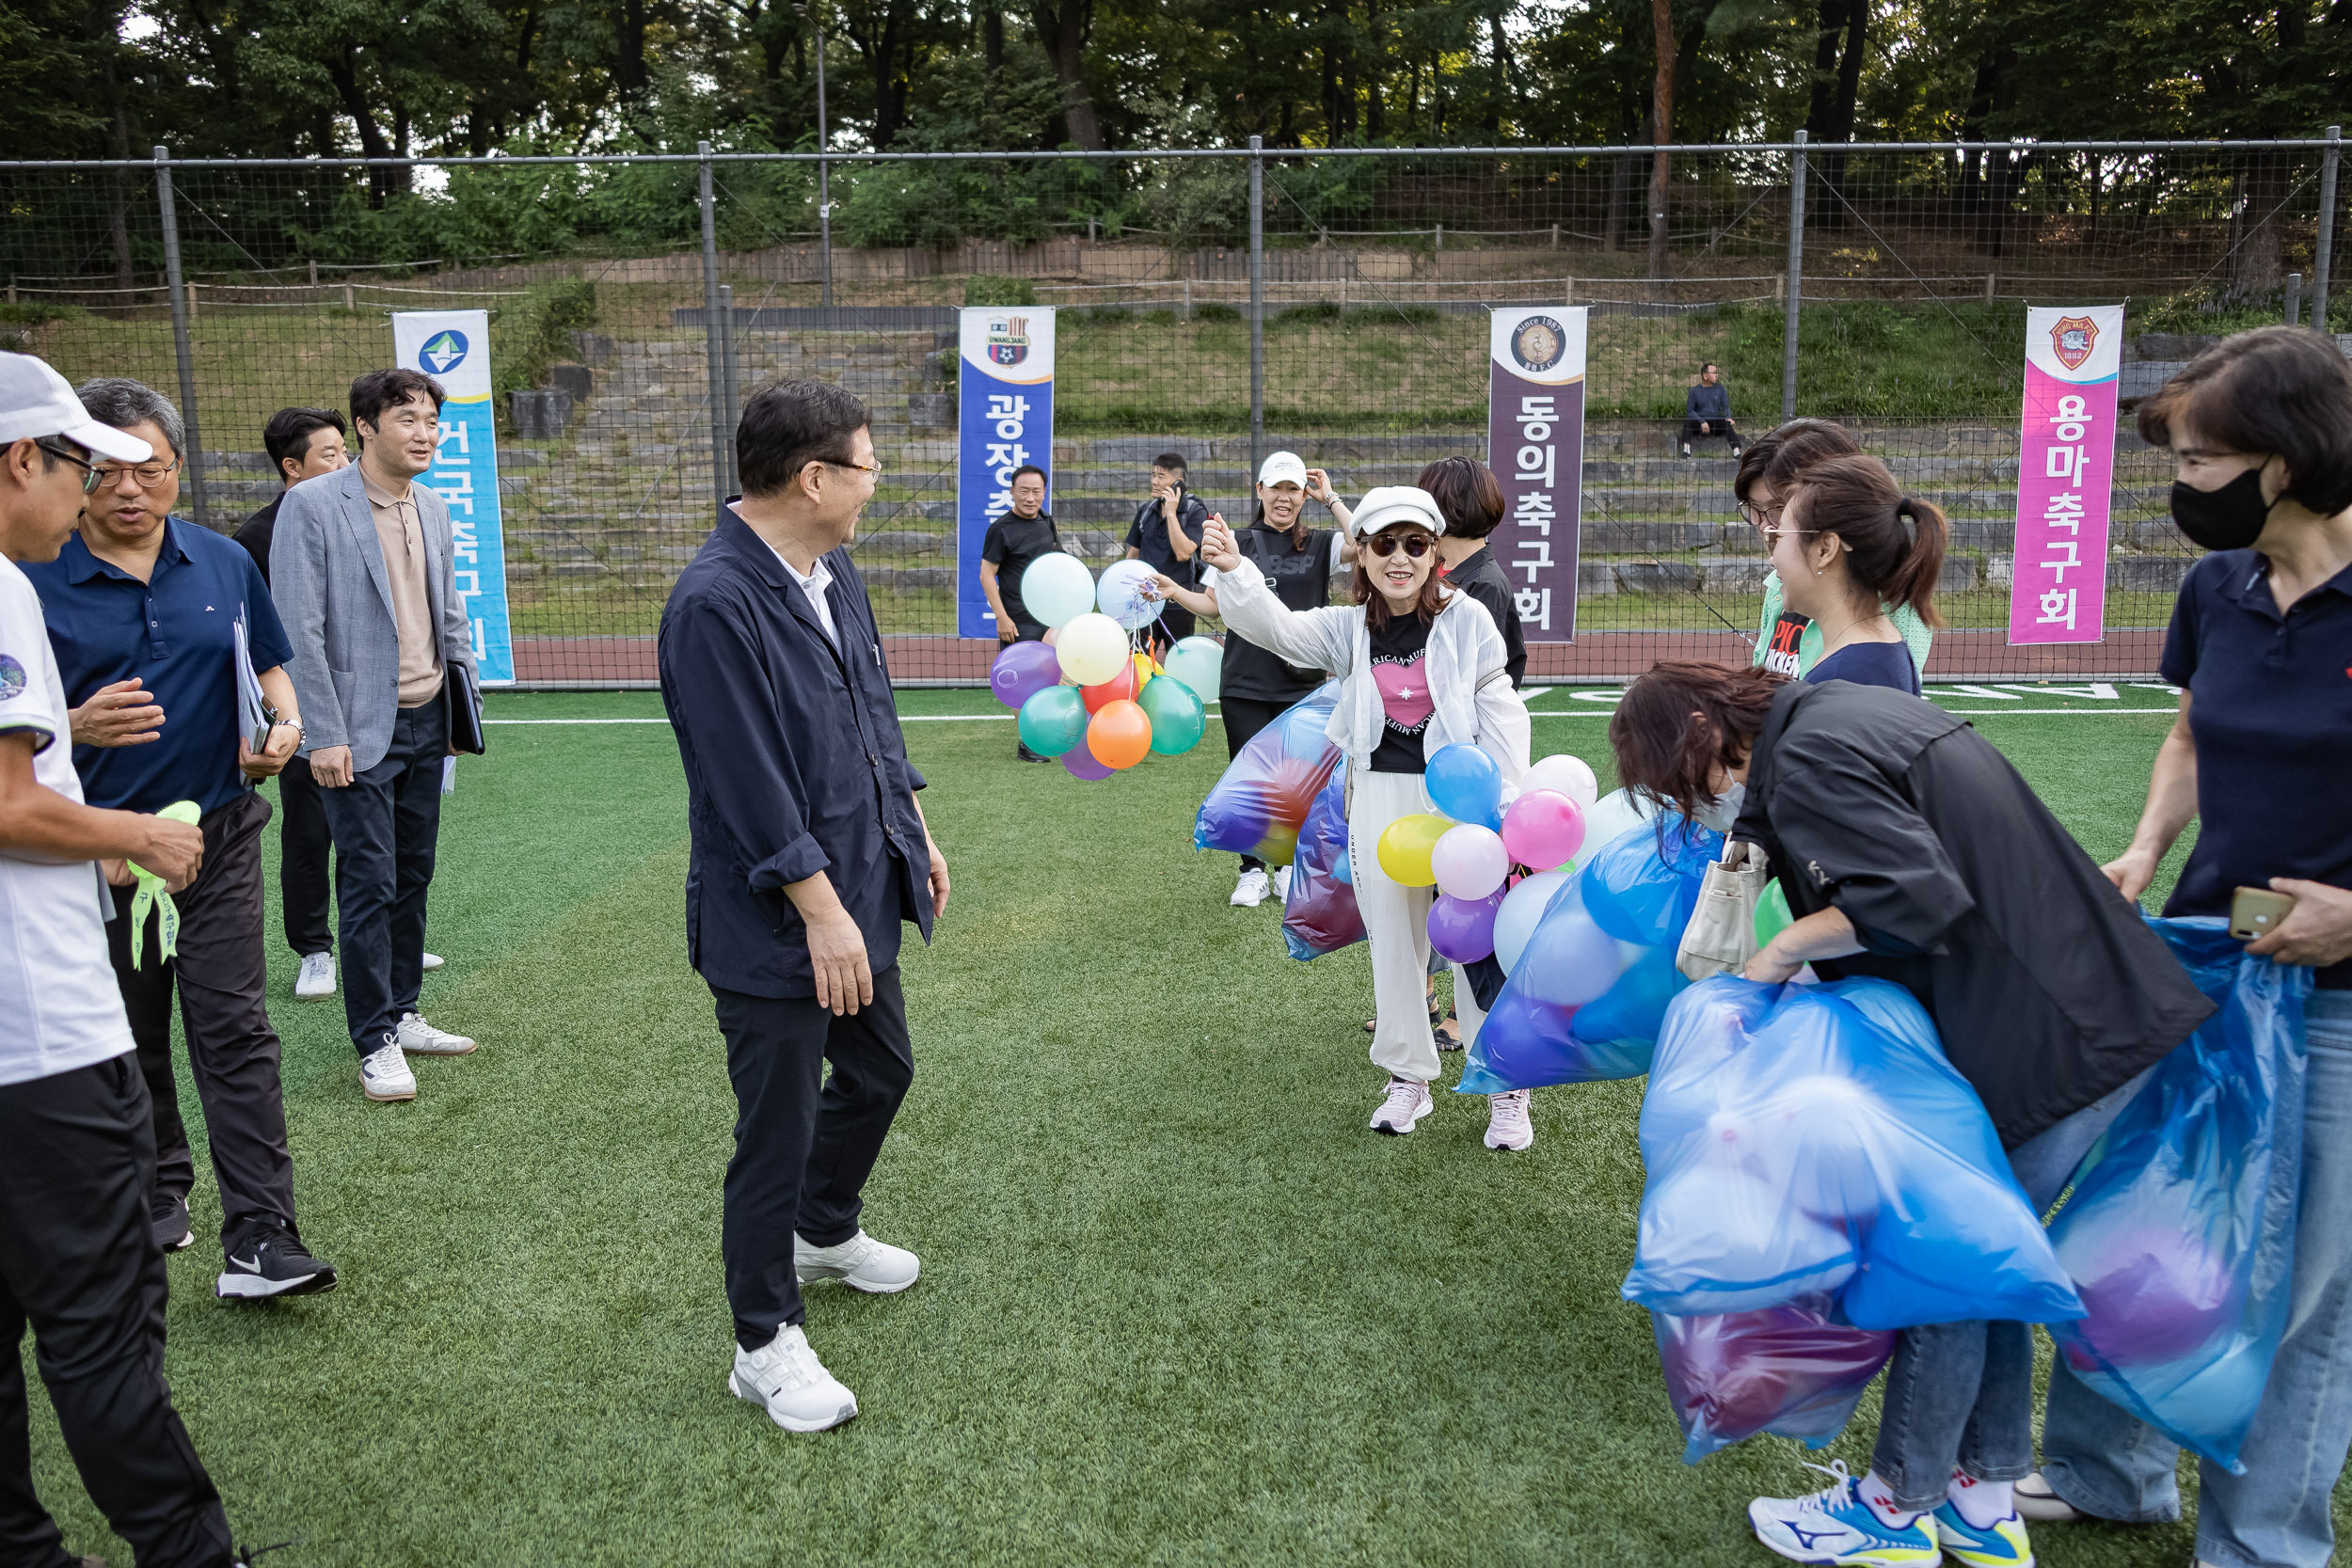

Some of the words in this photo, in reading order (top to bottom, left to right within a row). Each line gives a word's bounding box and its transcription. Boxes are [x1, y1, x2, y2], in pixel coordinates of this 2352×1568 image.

[1517, 318, 1539, 334] Since
[1542, 317, 1562, 332] 1987
[1512, 396, 1560, 630] 동의축구회
[2036, 395, 2093, 630] 용마축구회
